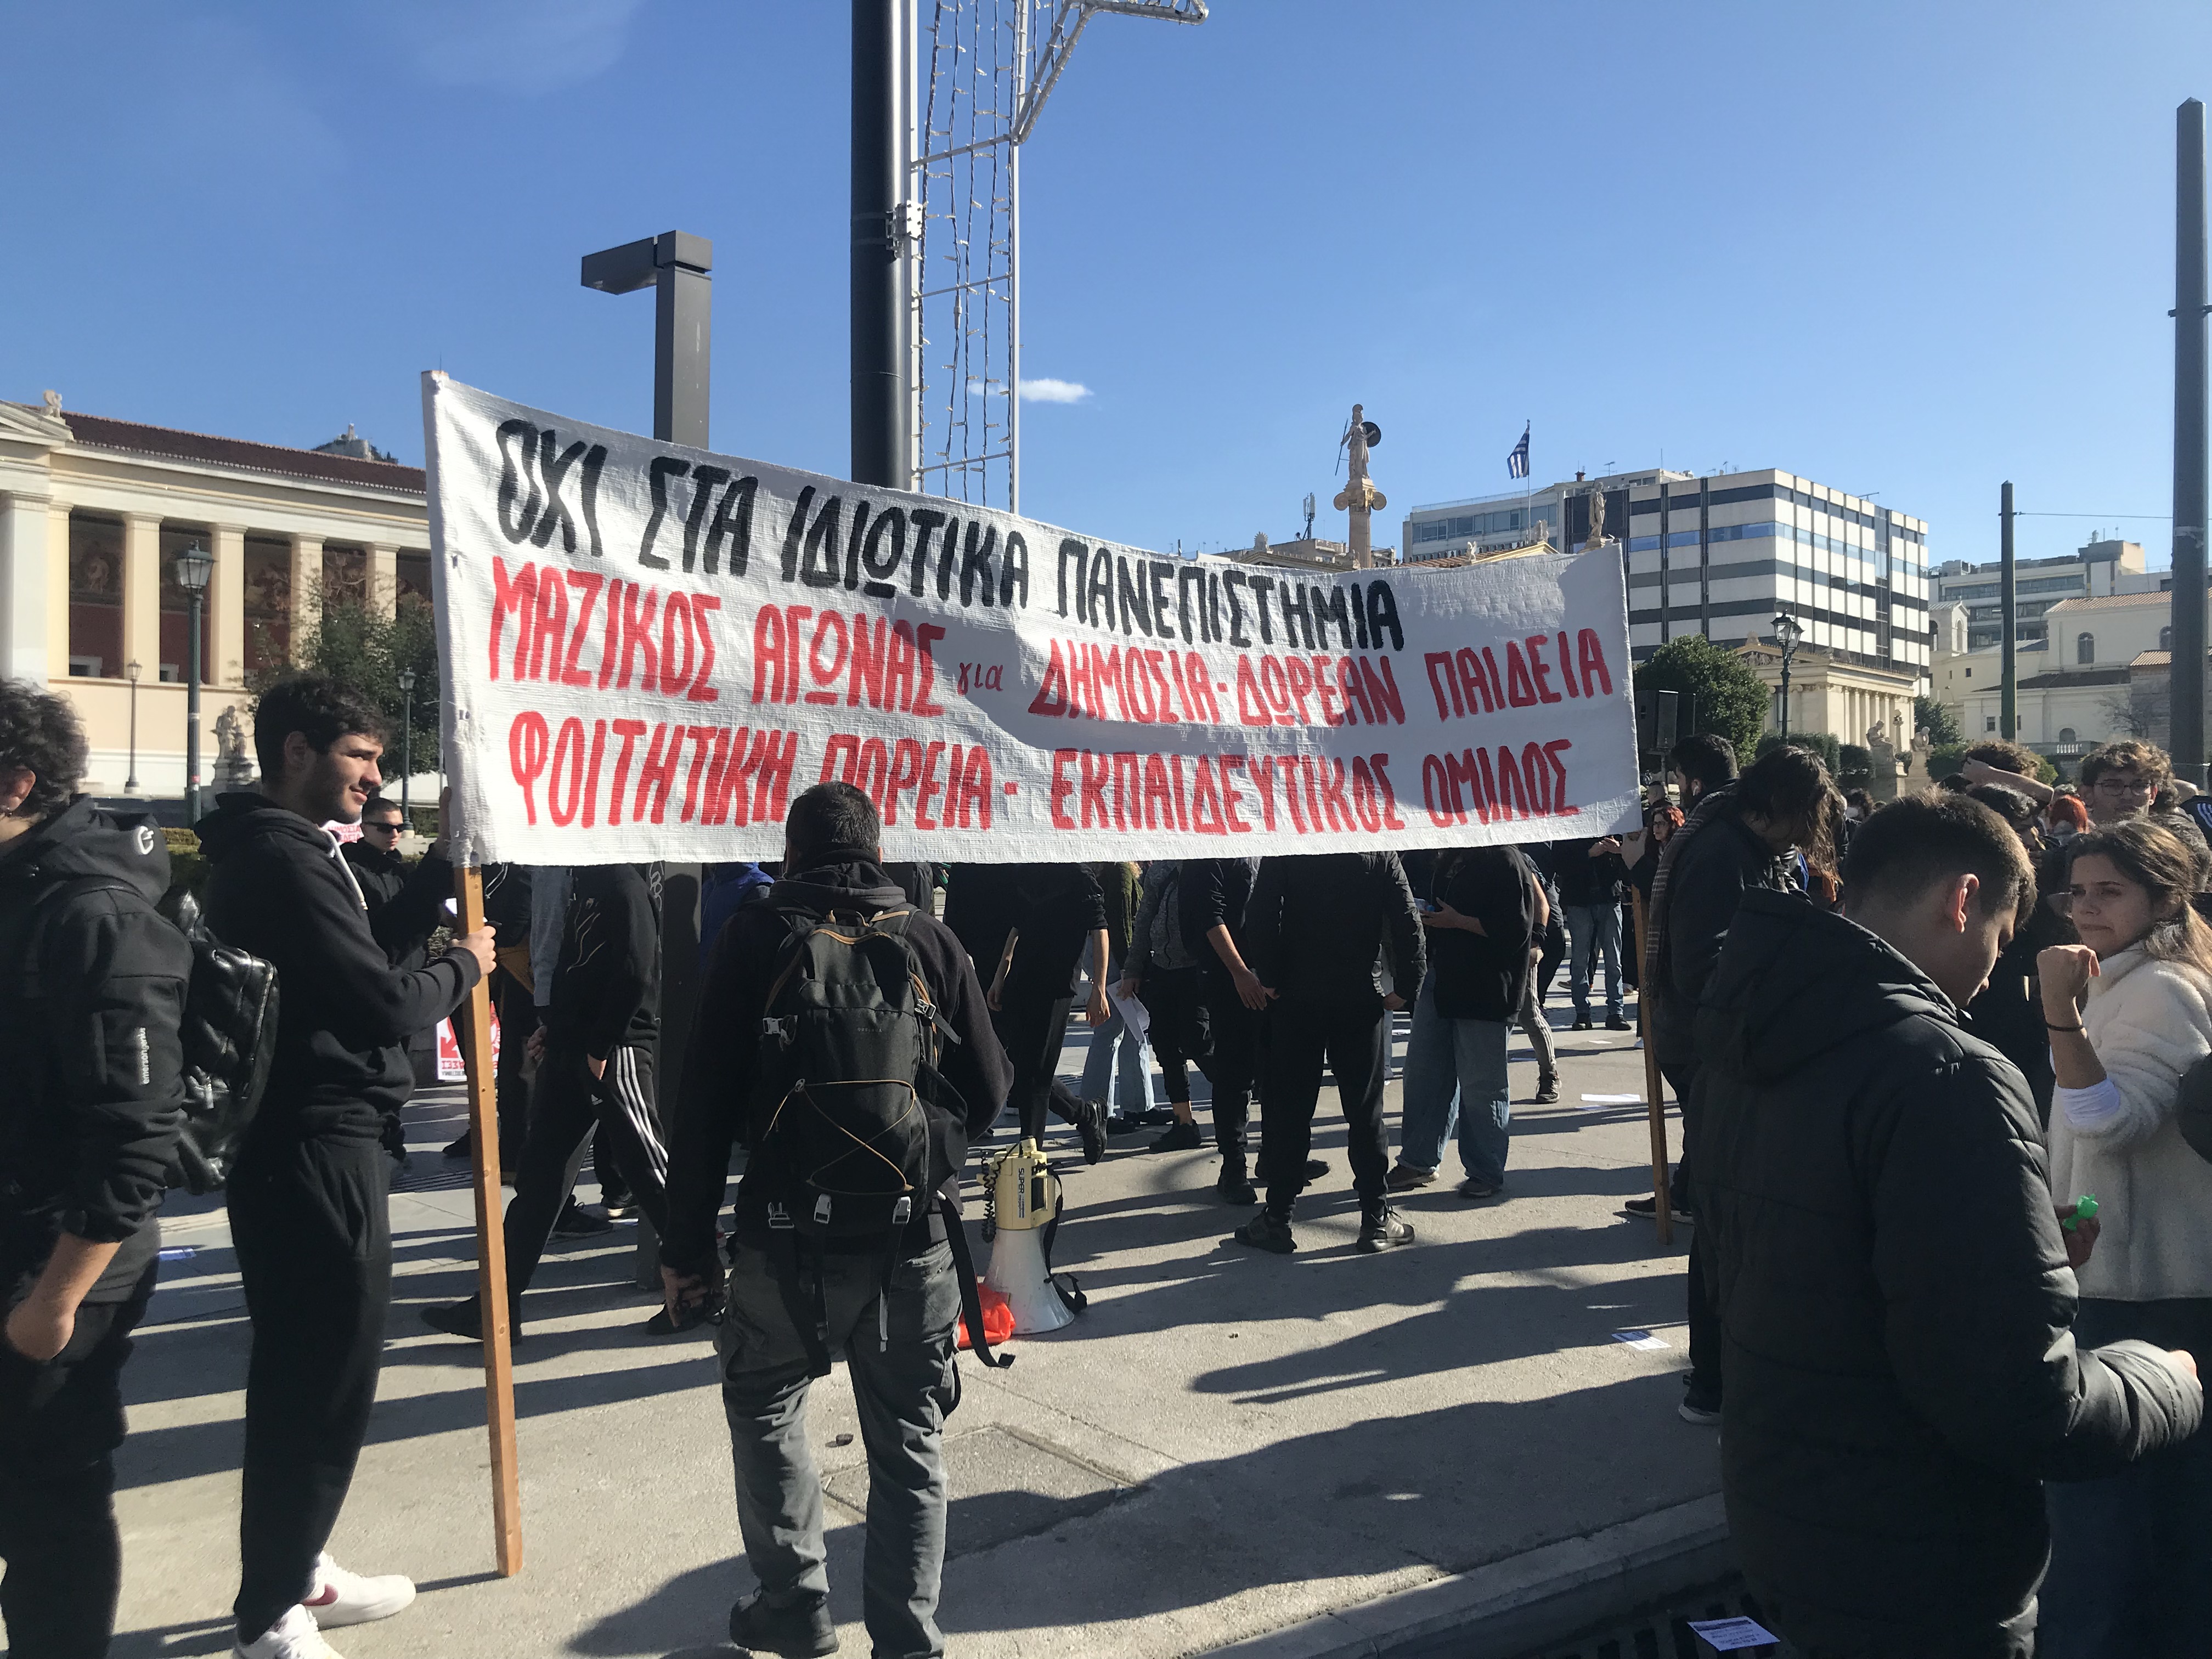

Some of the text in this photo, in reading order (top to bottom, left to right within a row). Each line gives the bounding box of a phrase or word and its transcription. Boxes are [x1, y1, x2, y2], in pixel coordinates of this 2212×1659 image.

[495, 419, 608, 556] ΟΧΙ
[639, 456, 759, 577] ΣΤΑ
[1057, 538, 1404, 651] ΠΑΝΕΠΙΣΤΗΜΙΑ
[489, 556, 721, 702] ΜΑΖΙΚΟΣ
[751, 603, 946, 717] ΑΓΩΝΑΣ
[957, 661, 1005, 695] για
[1425, 628, 1613, 723] ΠΑΙΔΕΙΑ
[509, 711, 799, 829] ΦΟΙΤΗΤΙΚΗ
[1050, 747, 1406, 836] ΕΚΠΑΙΔΕΥΤΙΚΟΣ
[1422, 738, 1580, 828] ΟΜΙΛΟΣ
